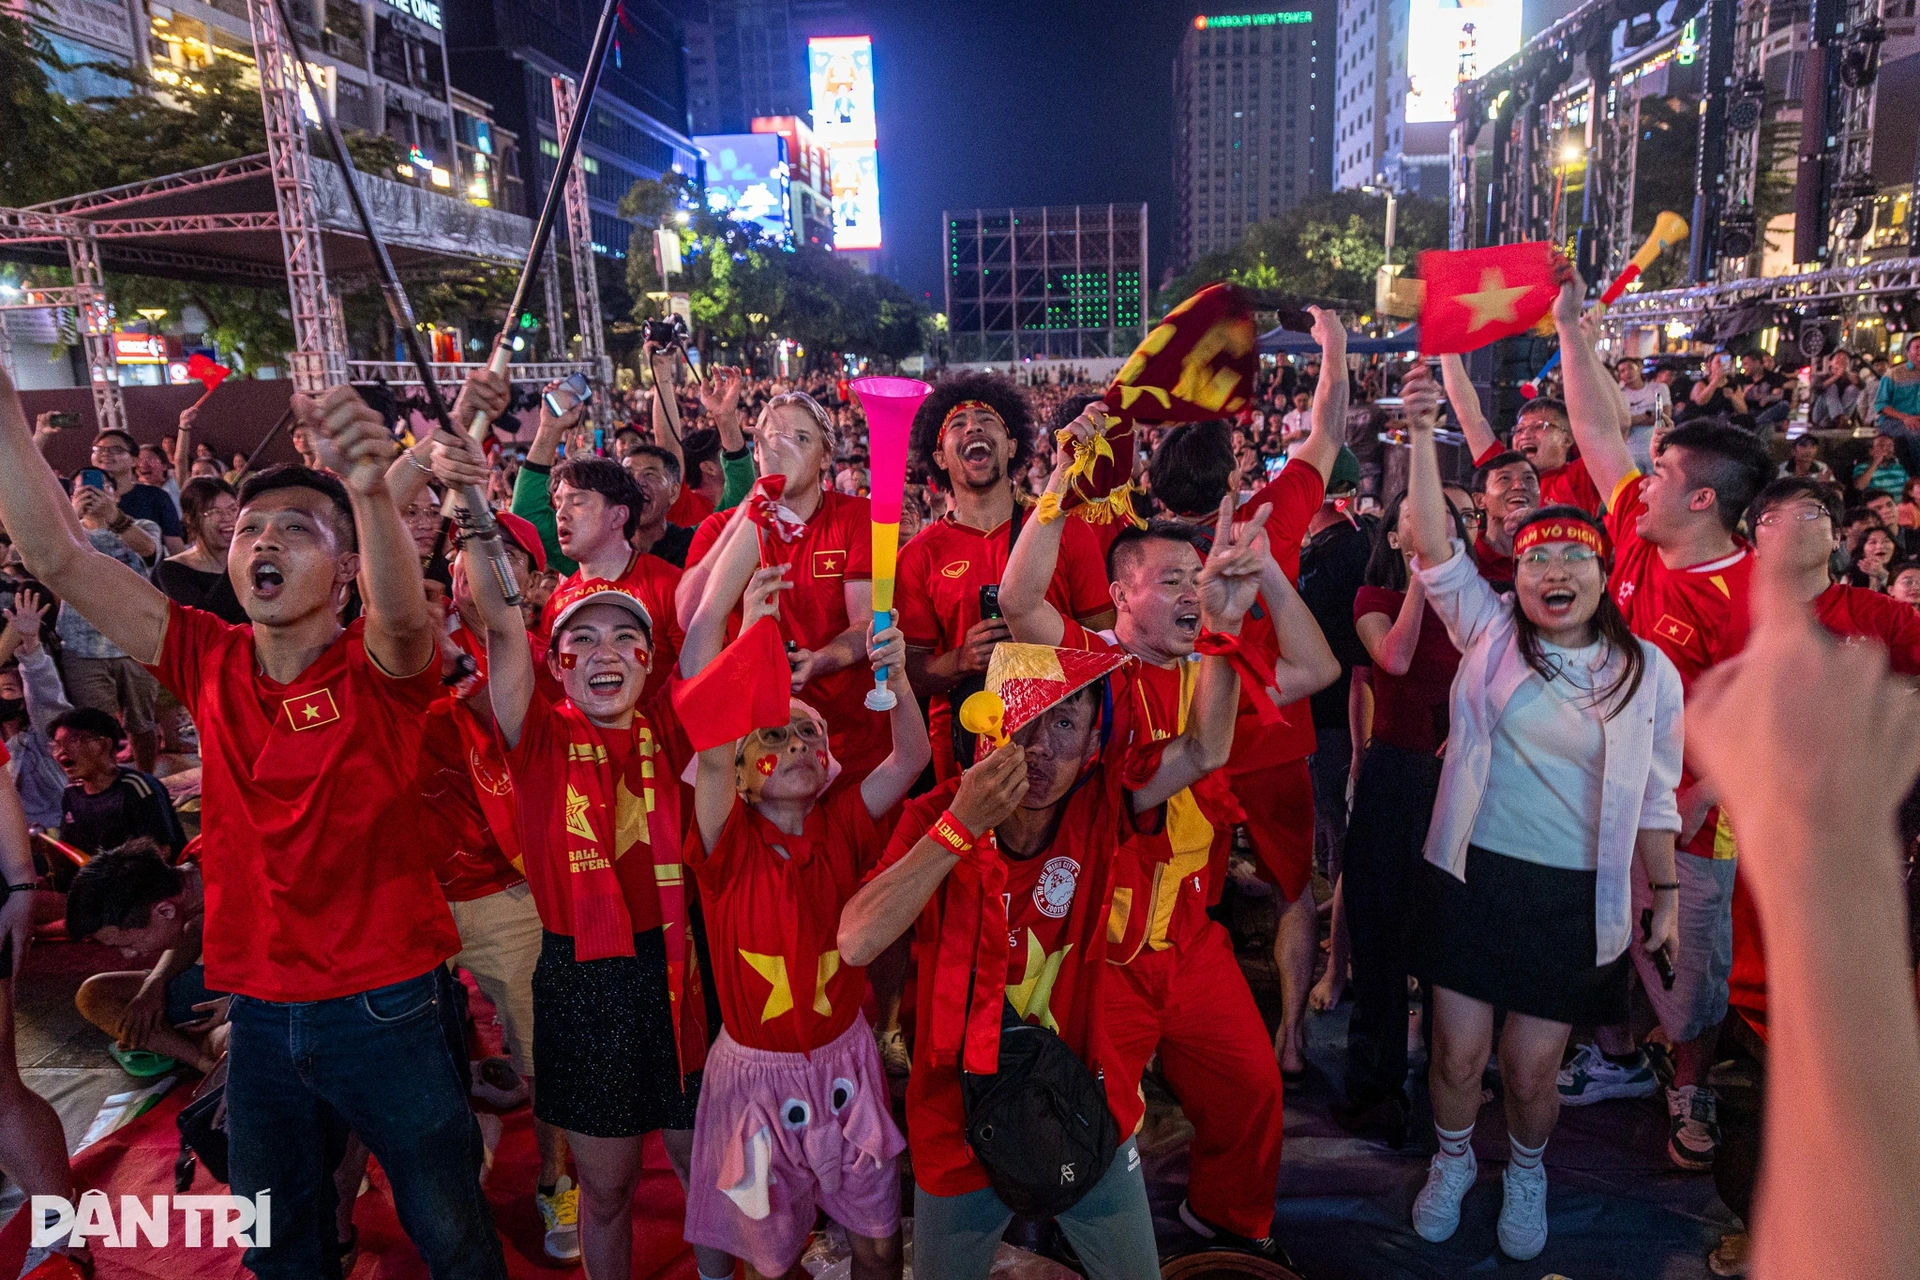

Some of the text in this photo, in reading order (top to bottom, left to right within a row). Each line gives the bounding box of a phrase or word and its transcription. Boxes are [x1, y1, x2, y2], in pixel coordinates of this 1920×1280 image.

[410, 0, 442, 31] ONE
[1207, 11, 1312, 28] HARBOUR VIEW TOWER
[1517, 529, 1537, 551] NAM
[1541, 524, 1562, 539] VÔ
[575, 584, 608, 598] NAM
[570, 858, 611, 873] RTERS
[1037, 861, 1076, 896] HO CHI MINH CITY
